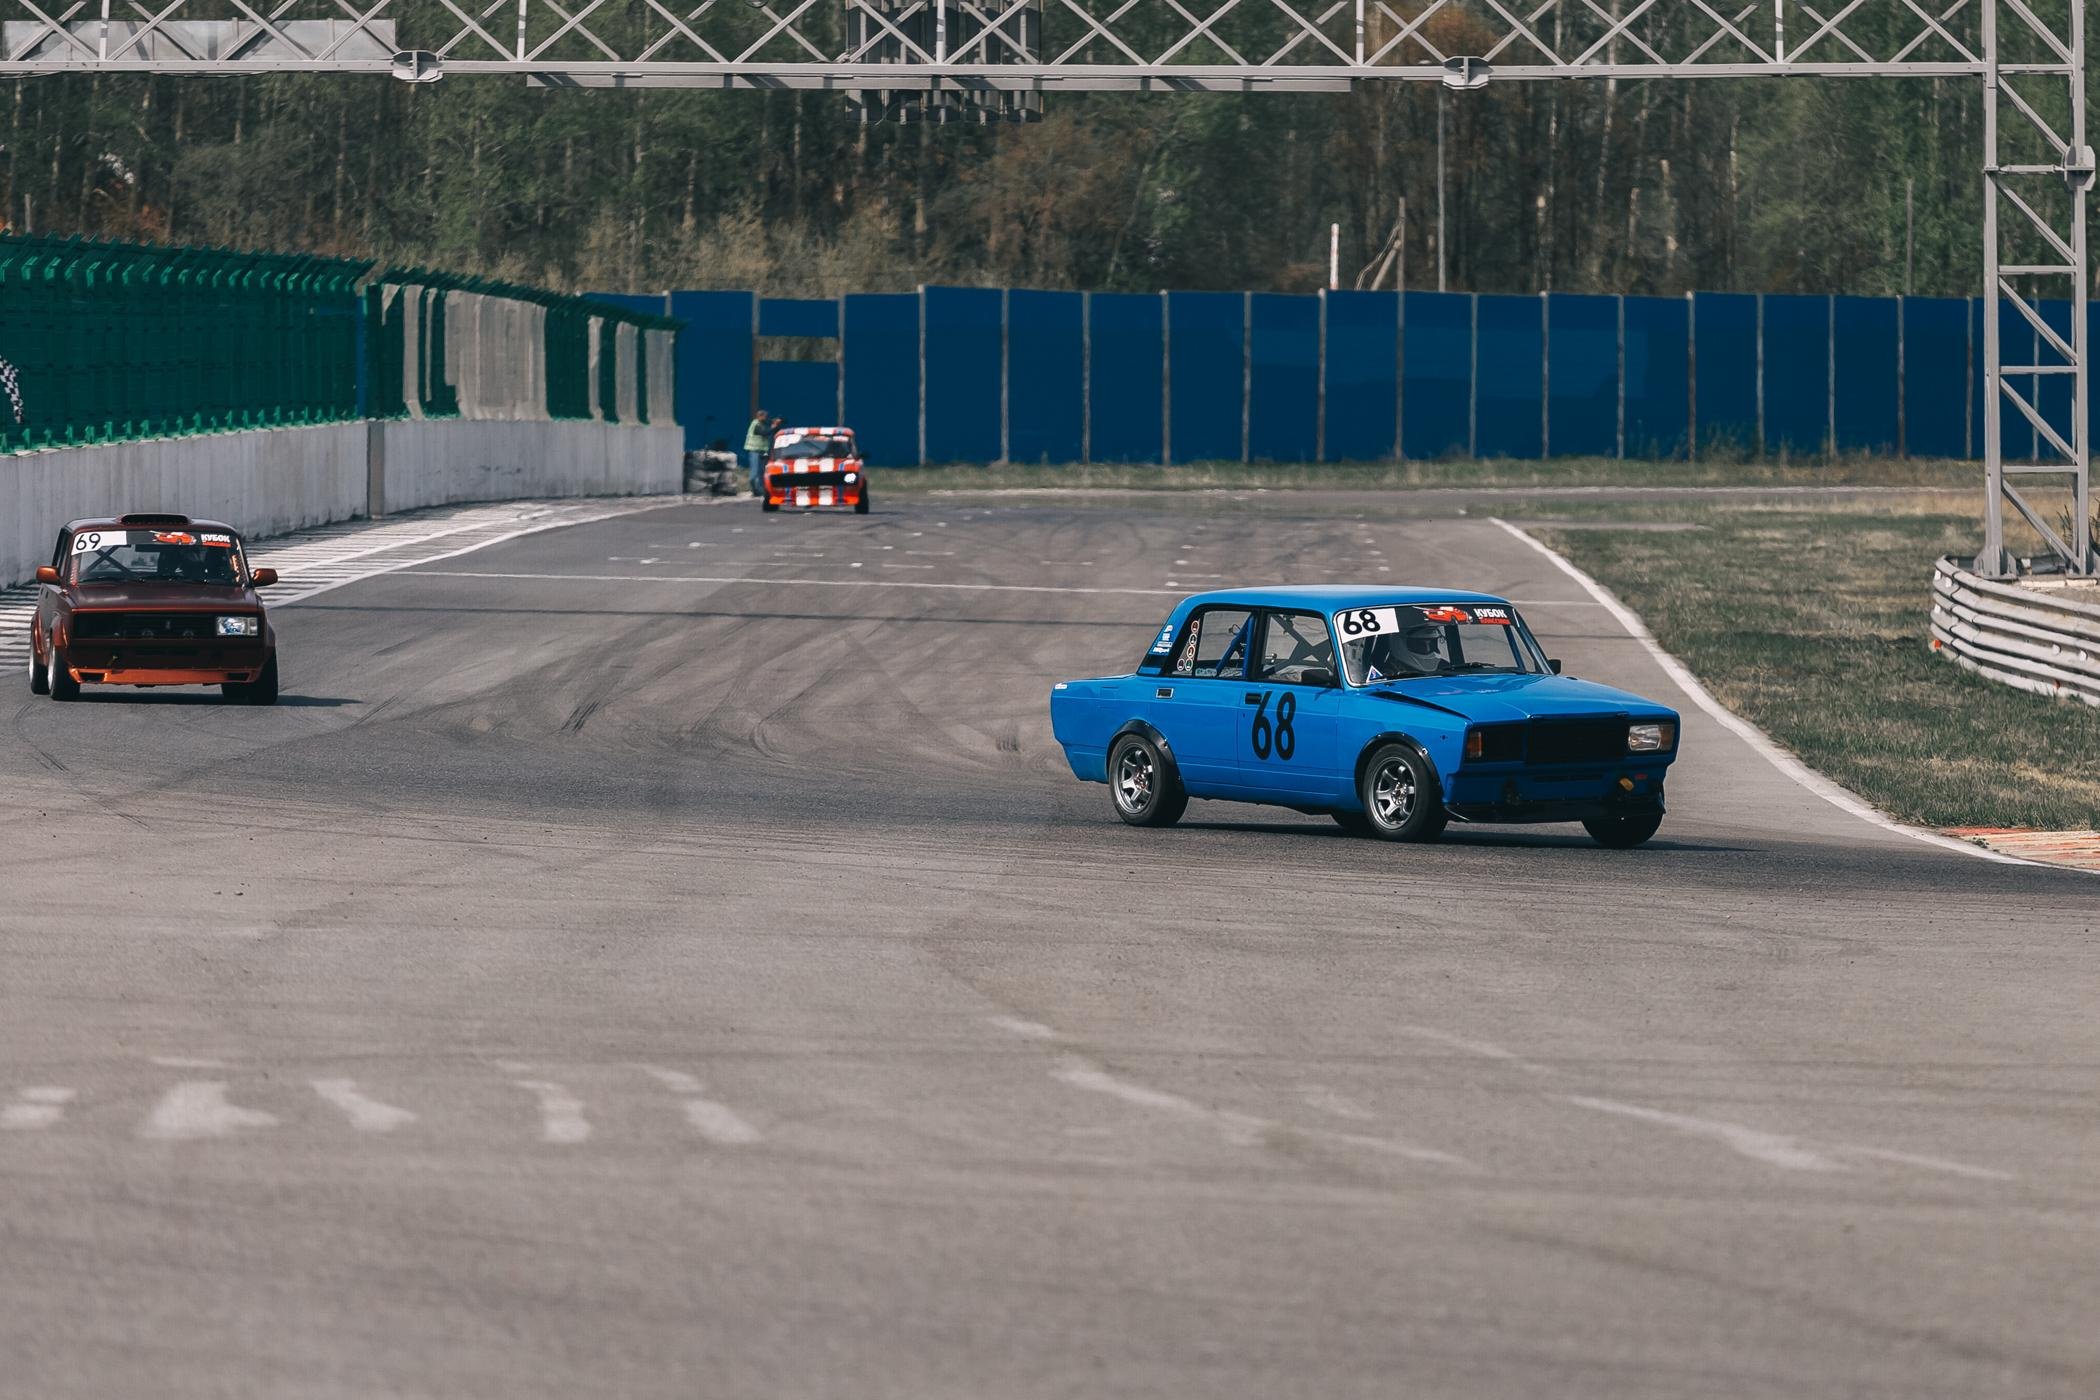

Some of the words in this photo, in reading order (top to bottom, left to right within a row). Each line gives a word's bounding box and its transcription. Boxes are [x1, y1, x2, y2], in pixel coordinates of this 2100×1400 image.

[76, 533, 101, 551] 69
[201, 534, 230, 542] КУБОК
[1343, 609, 1381, 635] 68
[1473, 608, 1508, 618] КУБОК
[1251, 690, 1297, 761] 68
